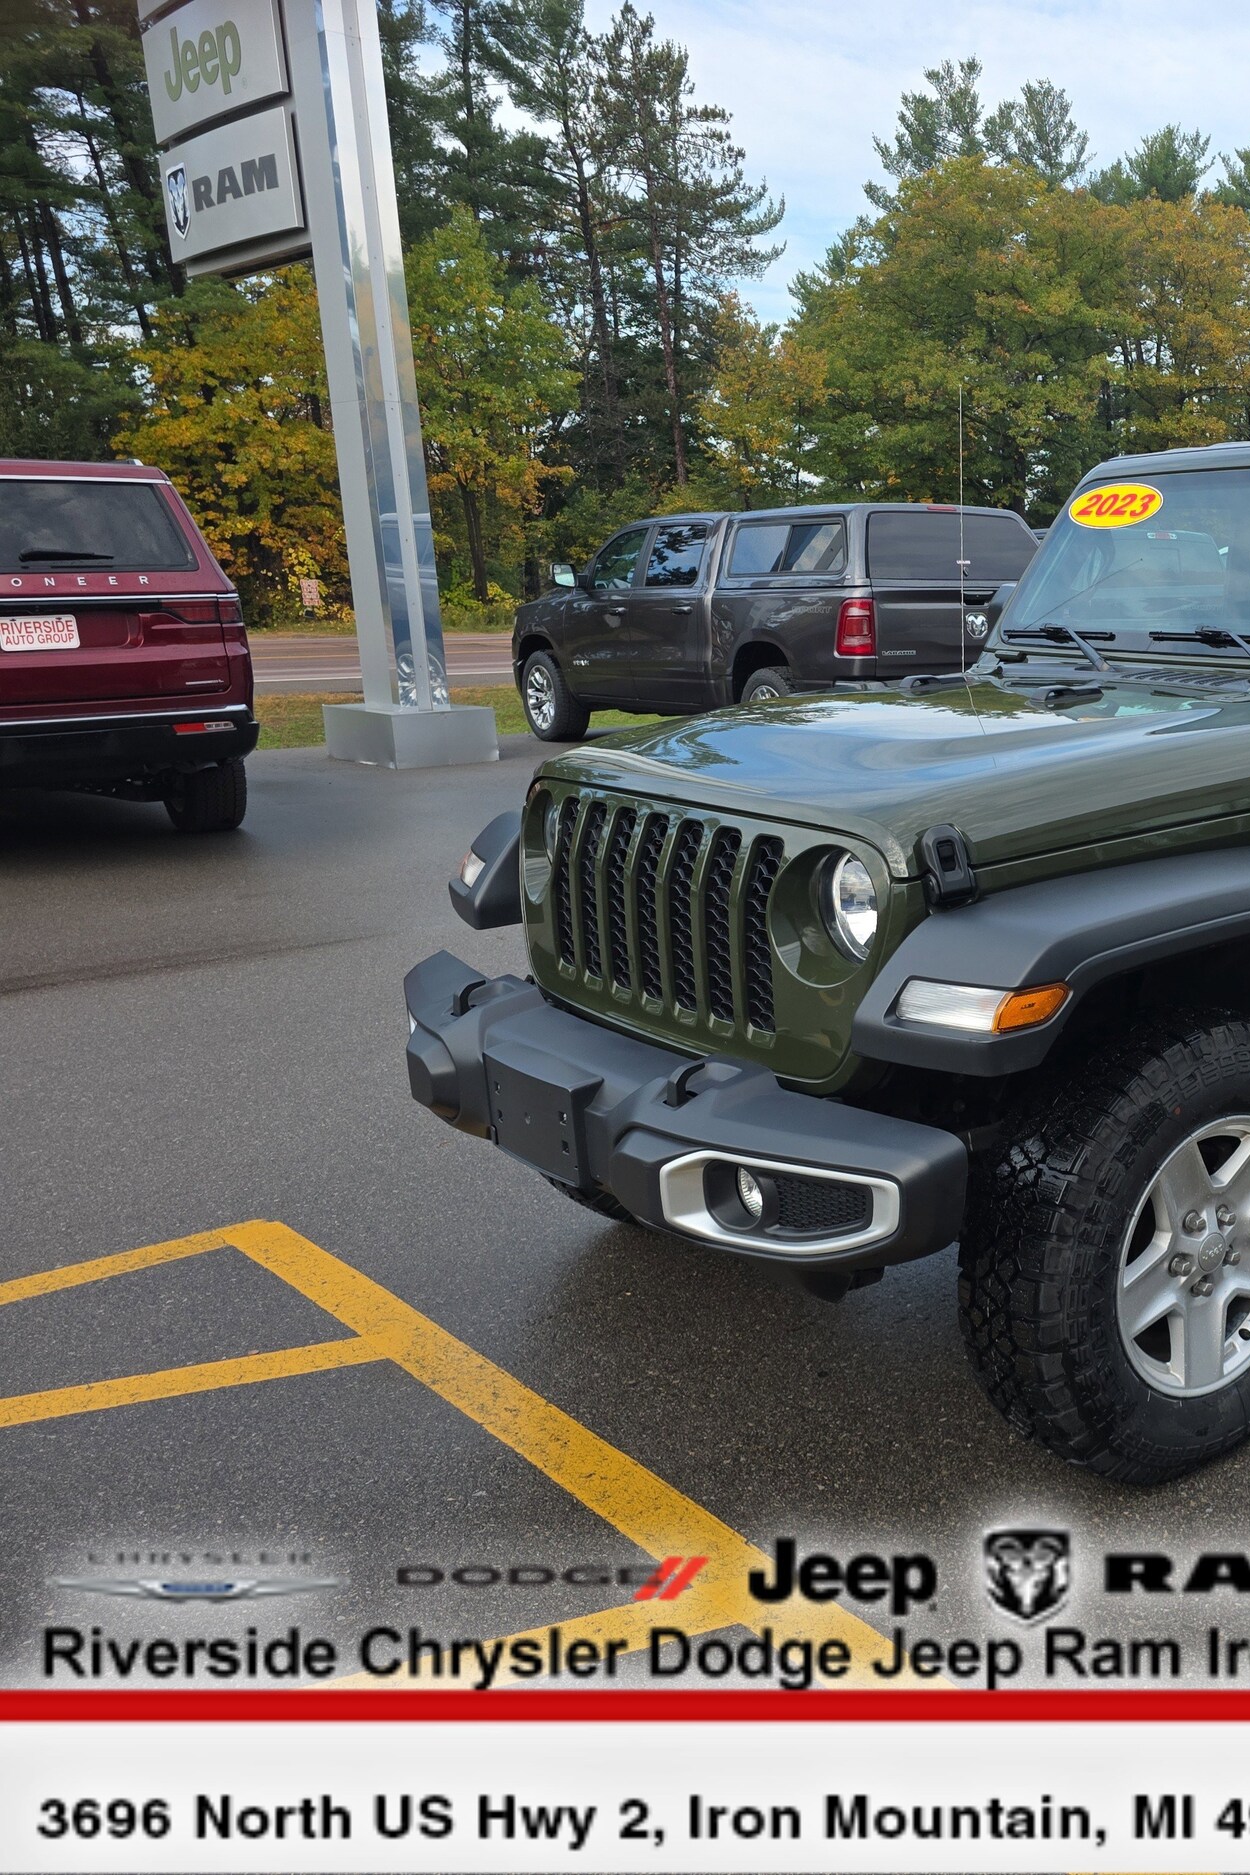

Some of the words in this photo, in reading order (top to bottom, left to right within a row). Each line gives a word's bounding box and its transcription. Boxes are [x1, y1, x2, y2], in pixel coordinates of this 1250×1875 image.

[163, 20, 242, 101] Jeep
[191, 153, 279, 212] RAM
[1076, 493, 1157, 517] 2023
[0, 620, 75, 635] RIVERSIDE
[5, 634, 35, 646] AUTO
[37, 633, 75, 644] GROUP
